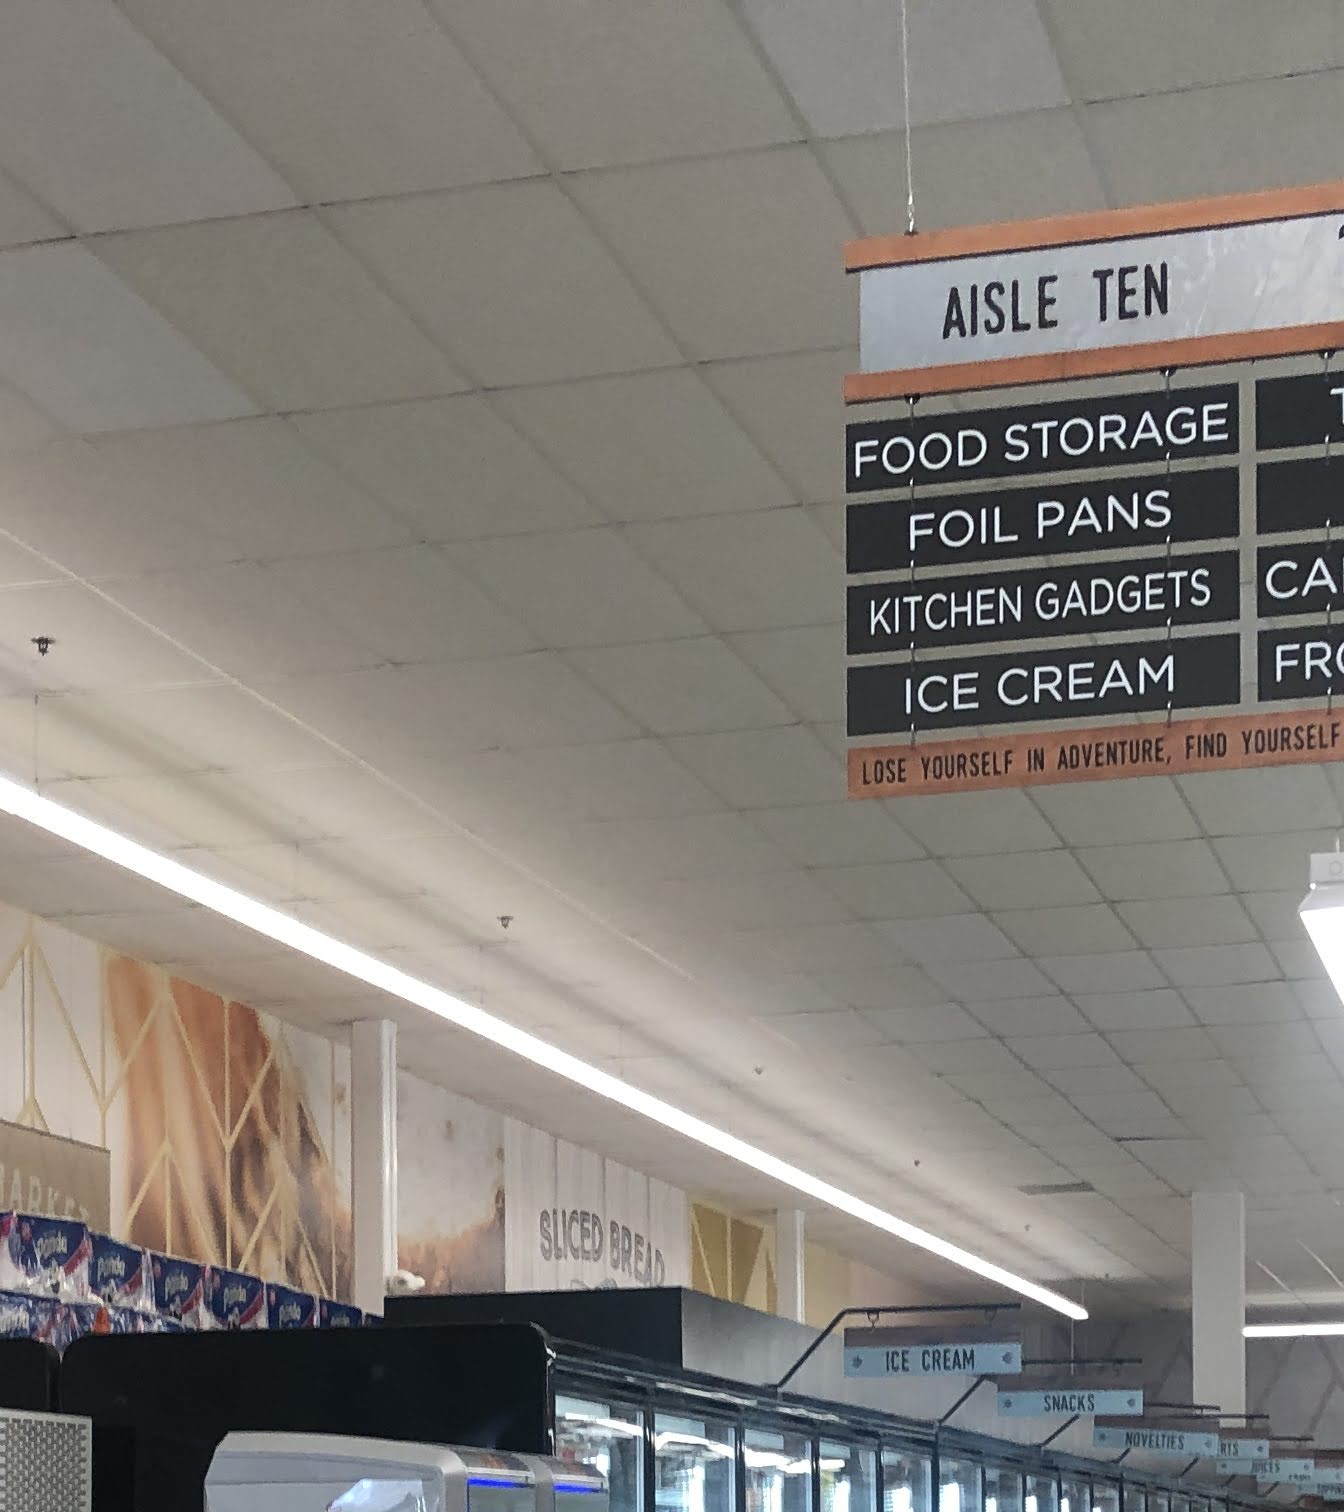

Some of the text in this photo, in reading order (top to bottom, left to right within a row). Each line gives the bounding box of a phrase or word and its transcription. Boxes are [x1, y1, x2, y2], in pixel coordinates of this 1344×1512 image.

[942, 261, 1169, 339] AISLE TEN
[854, 402, 1230, 478] FOOD STORAGE
[909, 490, 1172, 552] FOIL PANS
[869, 568, 1212, 637] KITCHEN GADGETS
[905, 654, 1176, 715] ICE CREAM
[862, 757, 908, 786] LOSE
[920, 749, 1014, 781] YOURSELF
[1027, 747, 1046, 773] IN
[1057, 736, 1172, 770] ADVENTURE,
[1185, 732, 1228, 760] FIND
[1242, 722, 1342, 755] YOURSELF
[539, 1207, 666, 1289] SLICED BREAD
[885, 1348, 976, 1372] ICE CREAM
[1044, 1392, 1096, 1412] SNACKS
[1125, 1431, 1185, 1450] NOVELTIES
